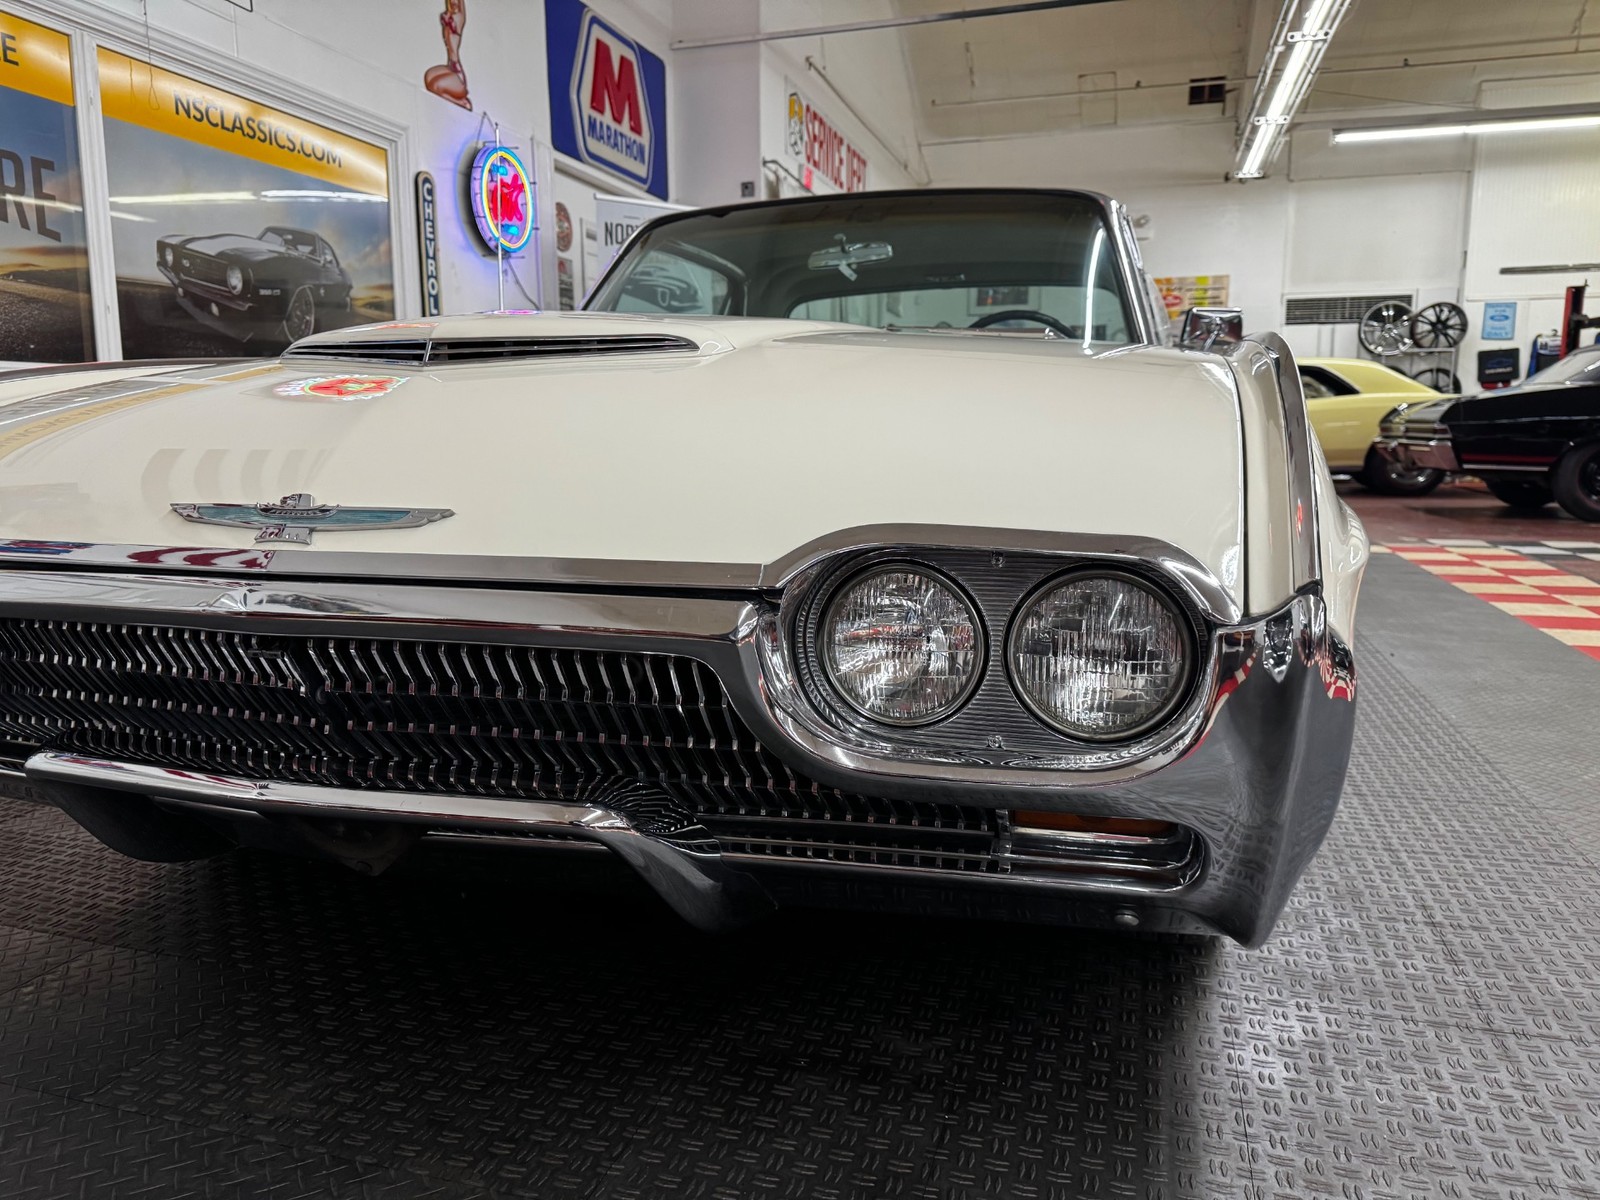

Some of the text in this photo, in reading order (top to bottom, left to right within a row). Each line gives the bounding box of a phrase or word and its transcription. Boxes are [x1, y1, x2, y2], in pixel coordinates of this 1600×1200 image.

[590, 37, 643, 137] M
[173, 92, 343, 168] NSCLASSICS.COM
[587, 115, 645, 167] MARATHON
[805, 103, 843, 190] SERVICE
